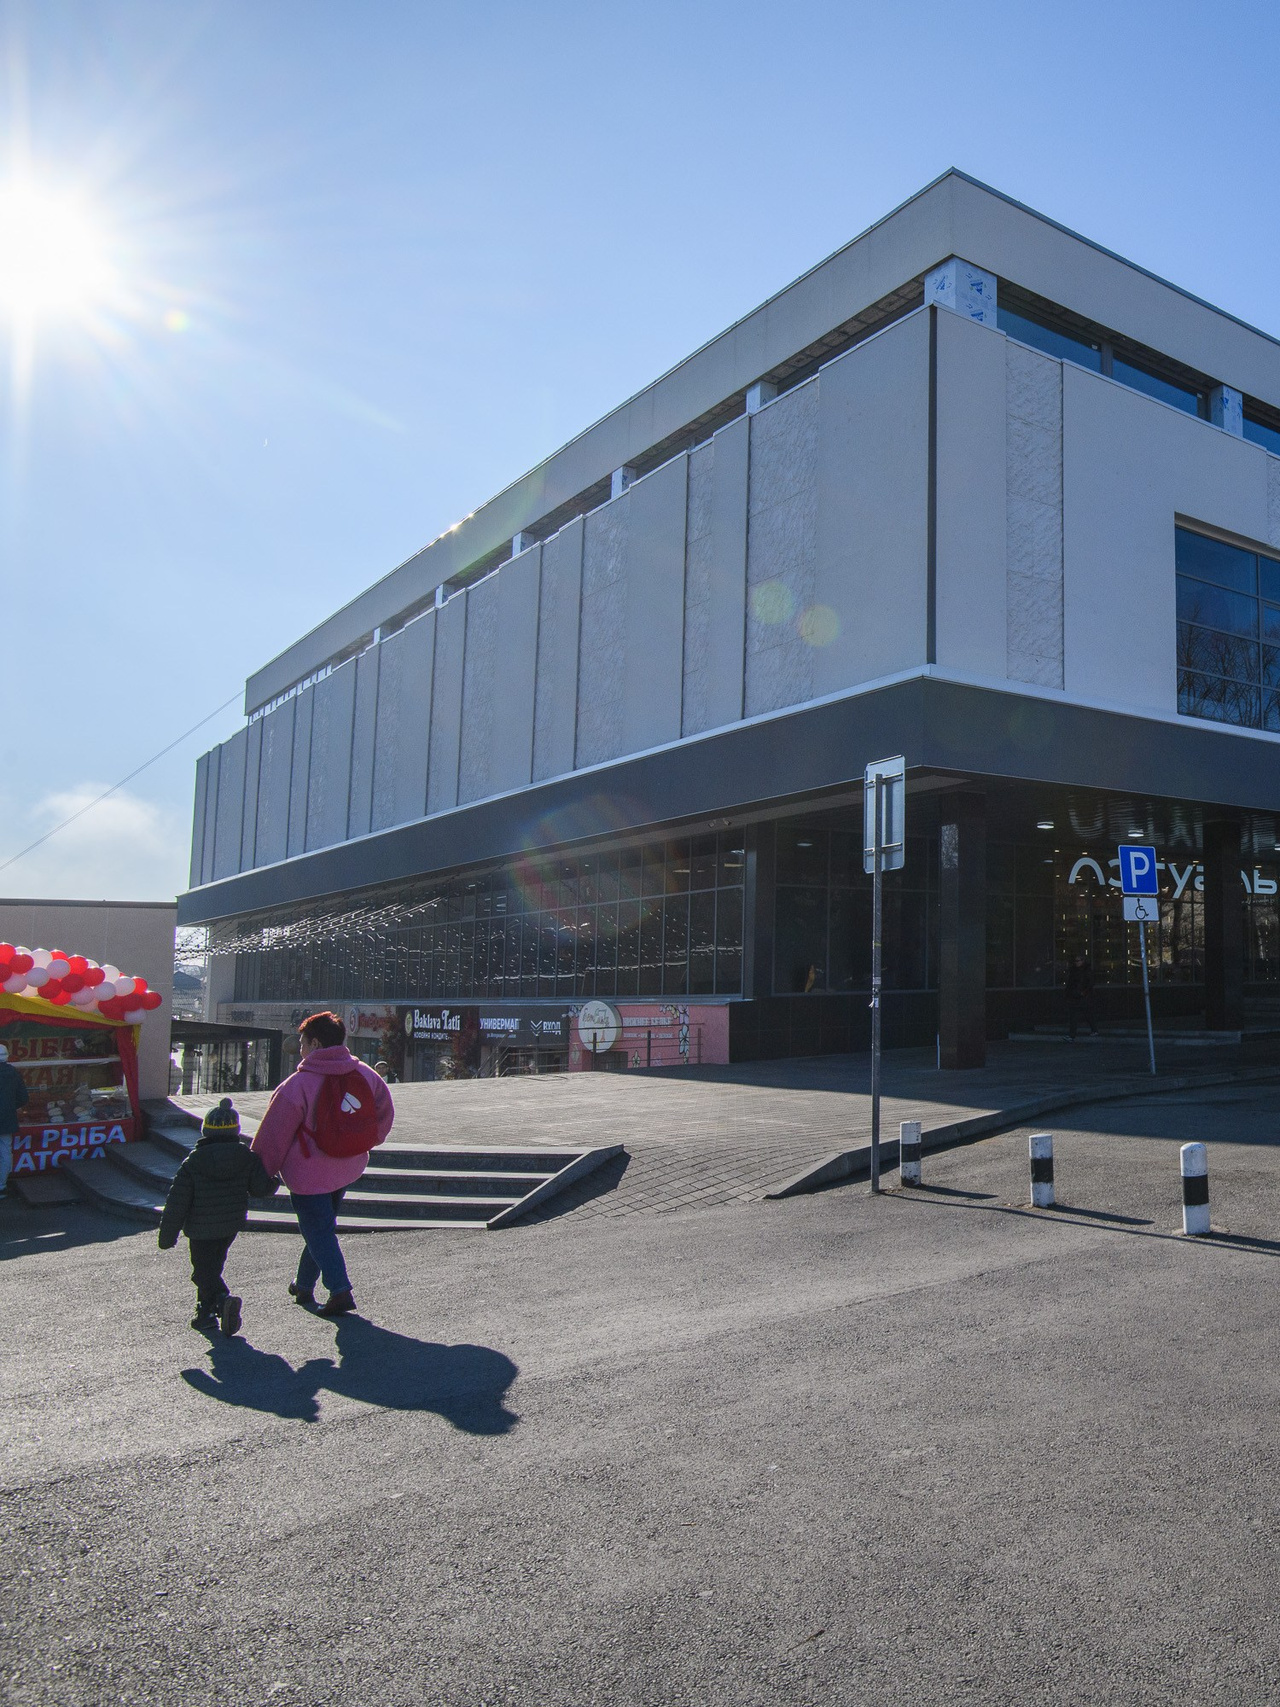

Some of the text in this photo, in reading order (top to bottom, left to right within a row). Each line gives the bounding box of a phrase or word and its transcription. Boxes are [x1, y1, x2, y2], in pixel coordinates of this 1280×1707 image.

[1130, 852, 1150, 888] P
[414, 1009, 461, 1031] Baklava Tatli
[41, 1125, 127, 1149] РЫБА
[13, 1147, 107, 1172] АТСКА
